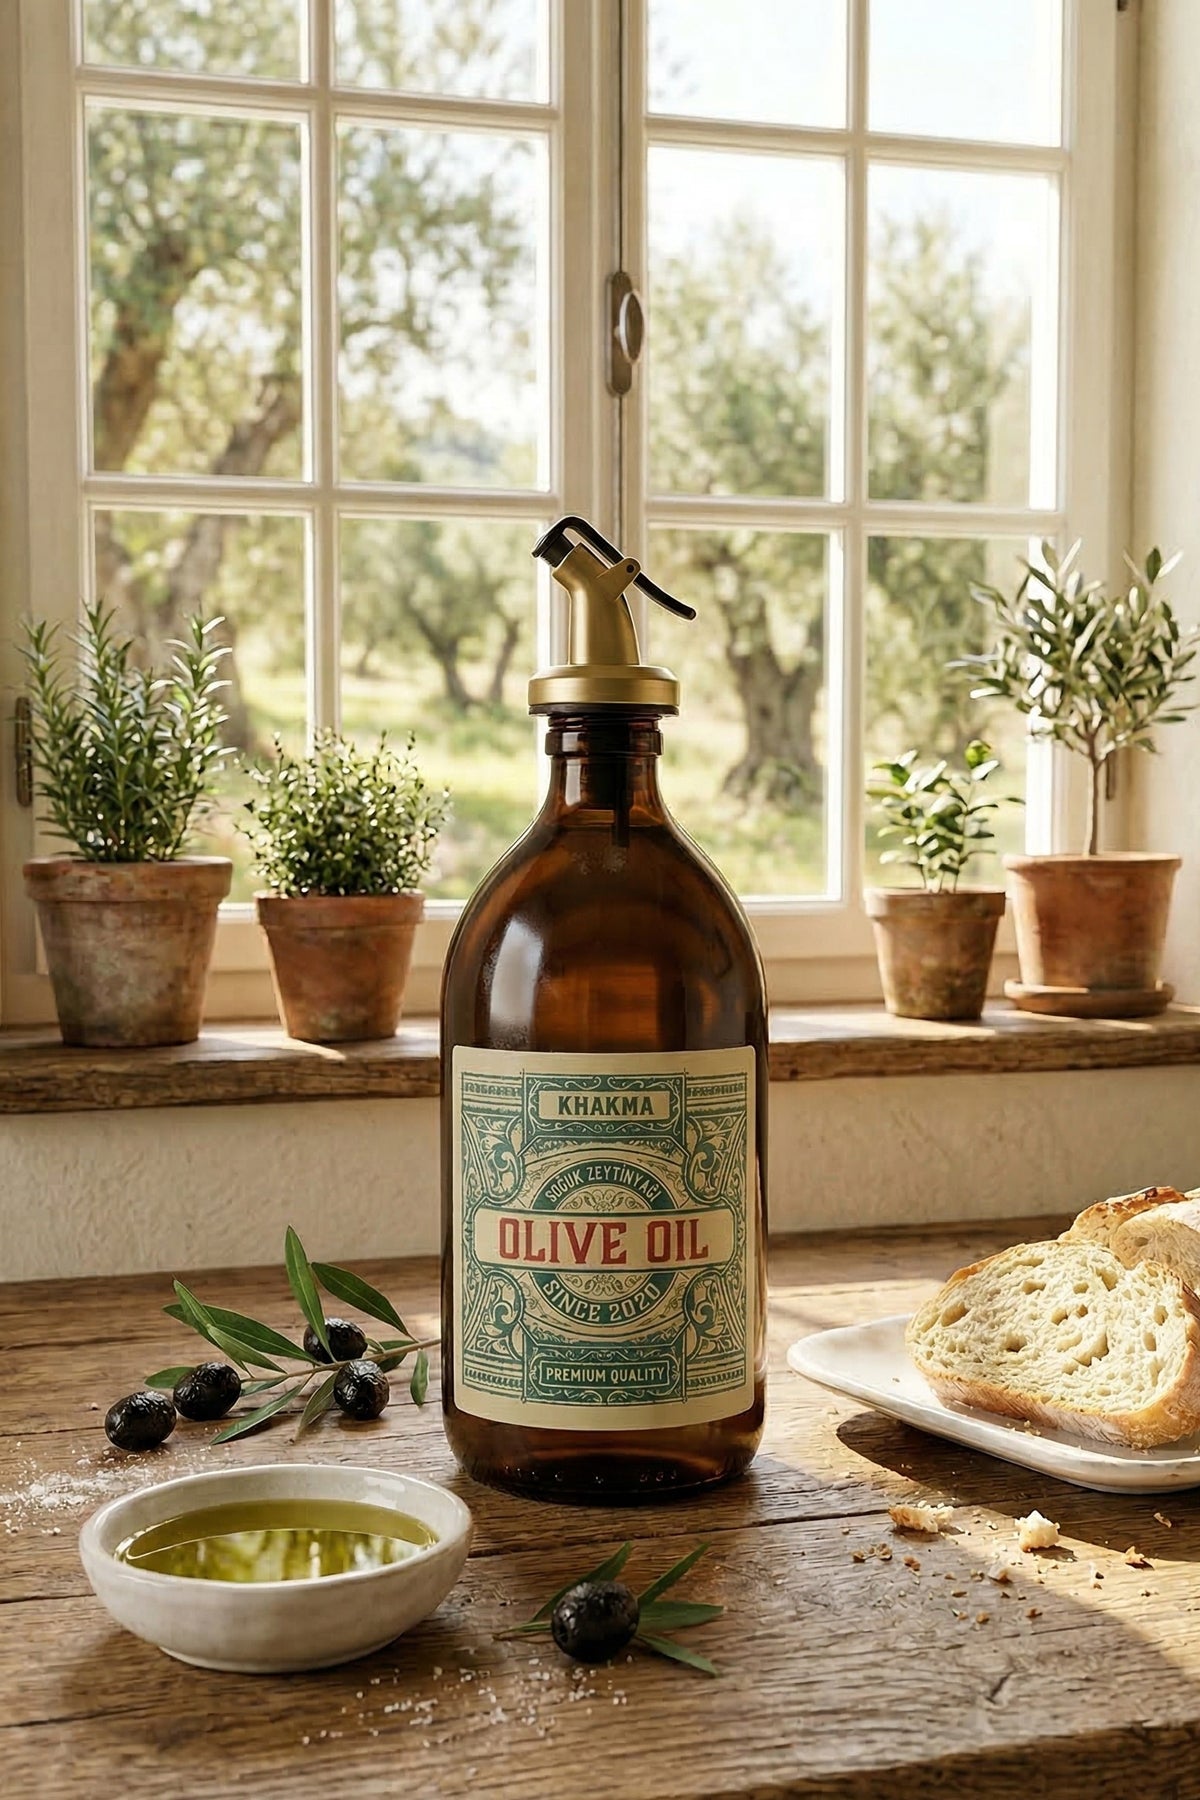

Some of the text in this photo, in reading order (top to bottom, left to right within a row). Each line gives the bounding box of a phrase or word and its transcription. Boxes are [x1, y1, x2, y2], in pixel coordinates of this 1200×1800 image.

[558, 1095, 654, 1116] KHAKMA
[545, 1169, 585, 1202] SOĞUK
[498, 1217, 709, 1265] OLIVE OIL
[543, 1279, 661, 1322] SINCE 2020
[546, 1367, 665, 1384] PREMIUM QUALITY
